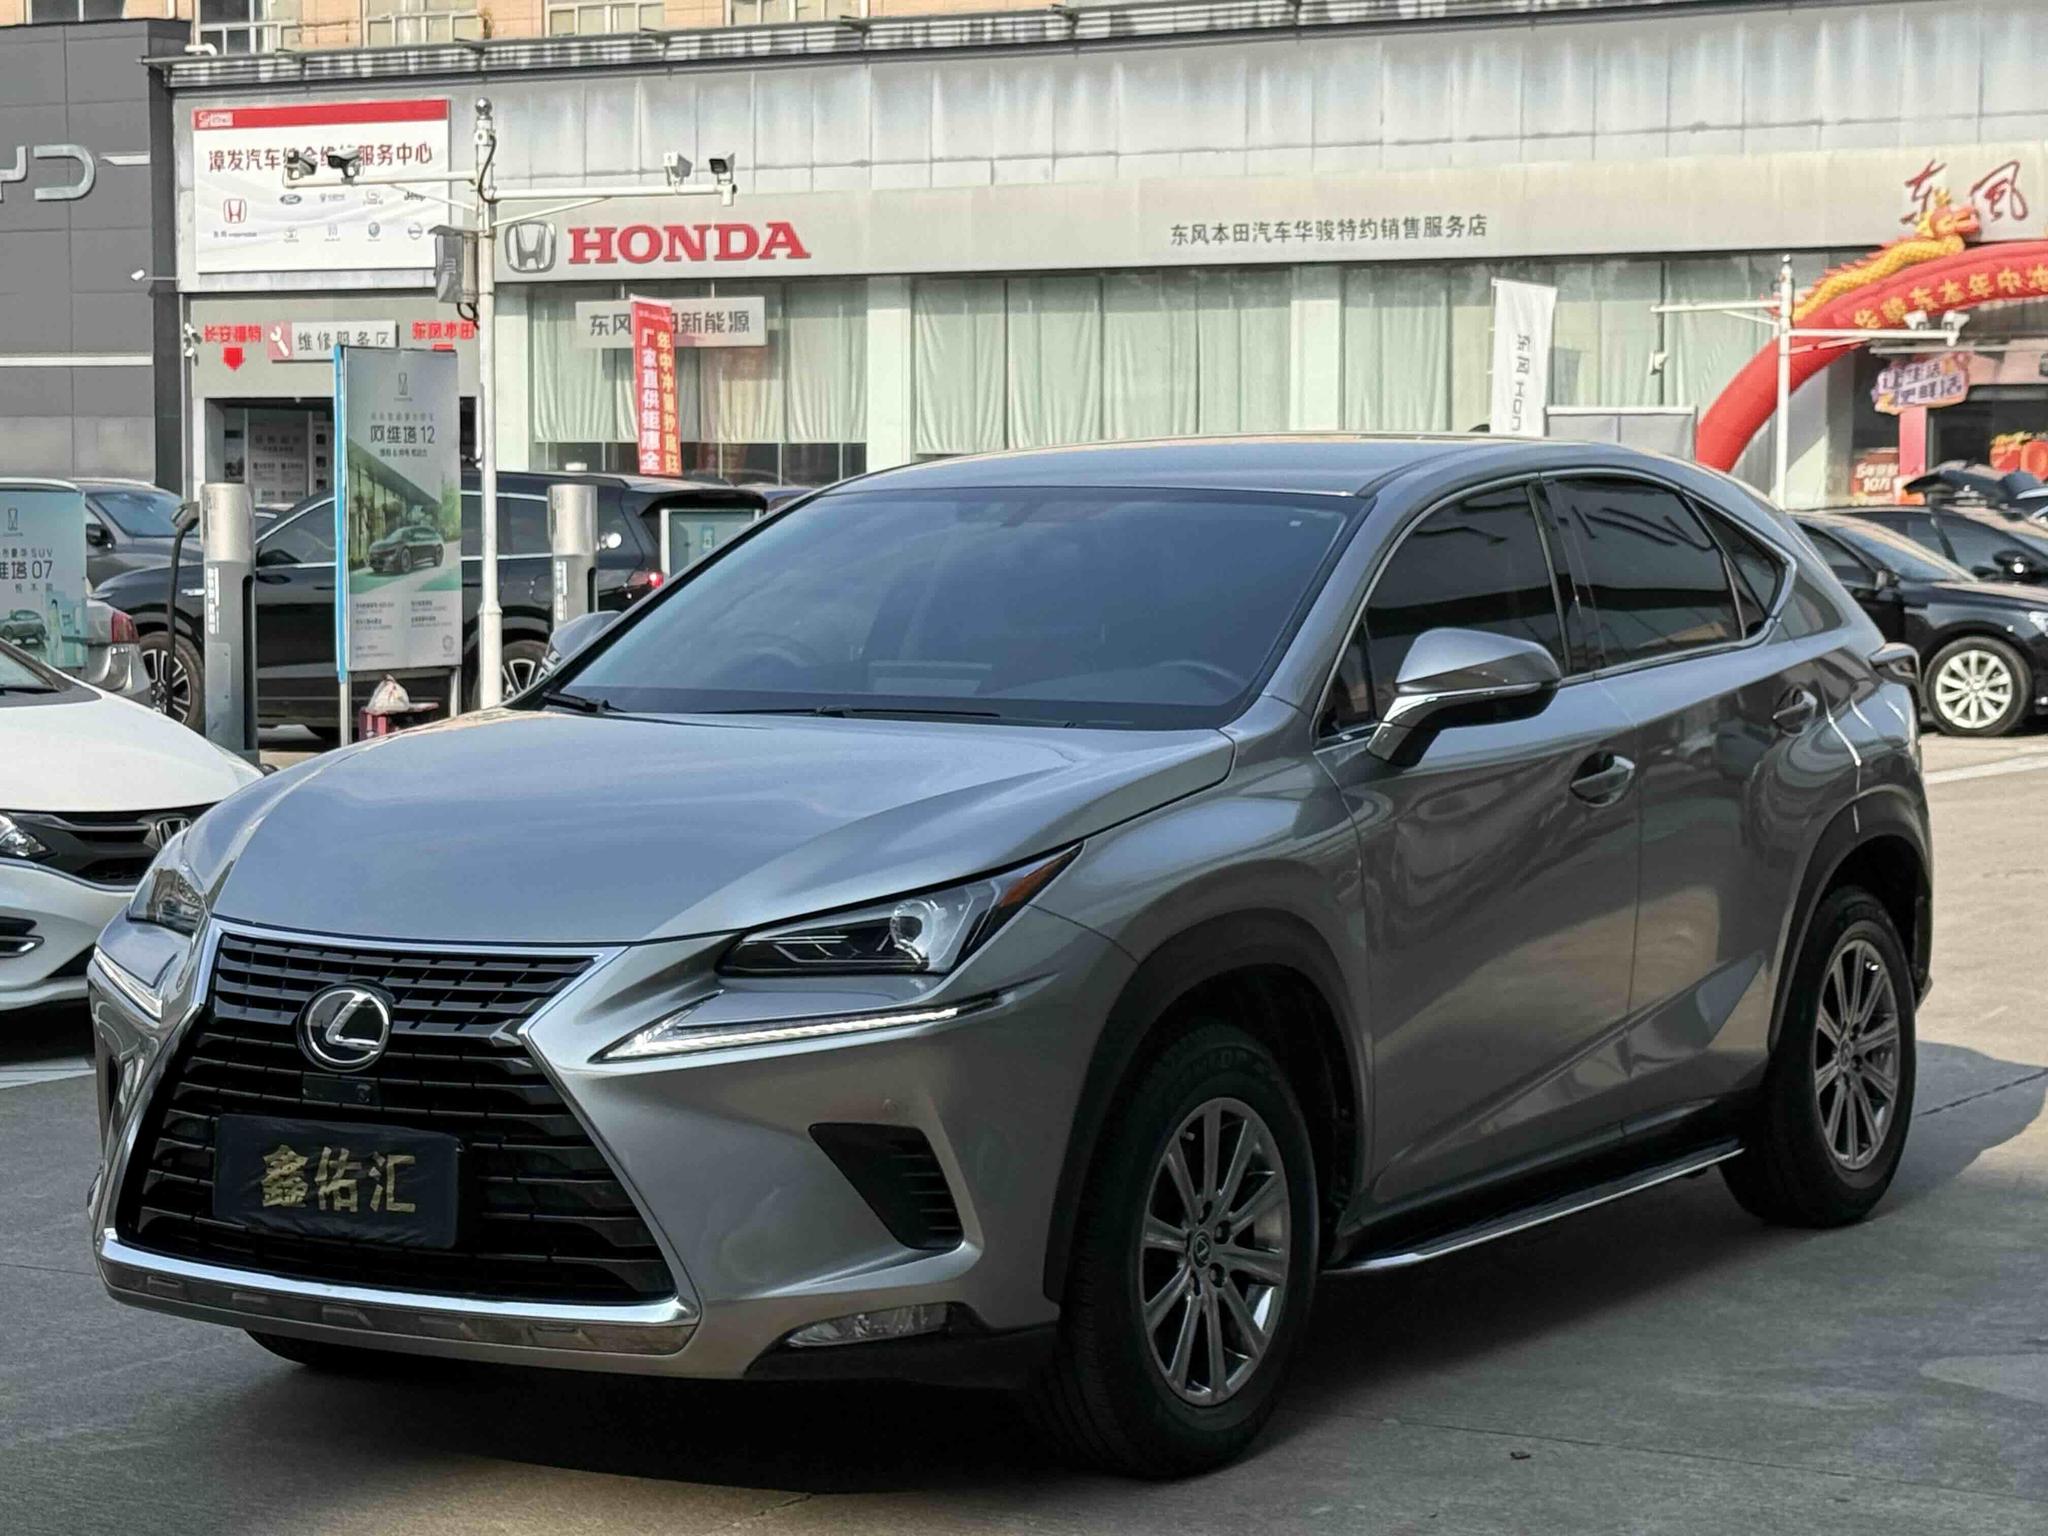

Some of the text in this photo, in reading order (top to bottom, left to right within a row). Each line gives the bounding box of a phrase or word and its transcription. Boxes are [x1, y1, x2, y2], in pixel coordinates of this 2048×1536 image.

[567, 222, 811, 265] HONDA
[1170, 214, 1488, 246] 东风本田汽车华骏特约销售服务店
[589, 310, 750, 337] 东风新能源
[261, 1144, 416, 1213] 鑫佑汇
